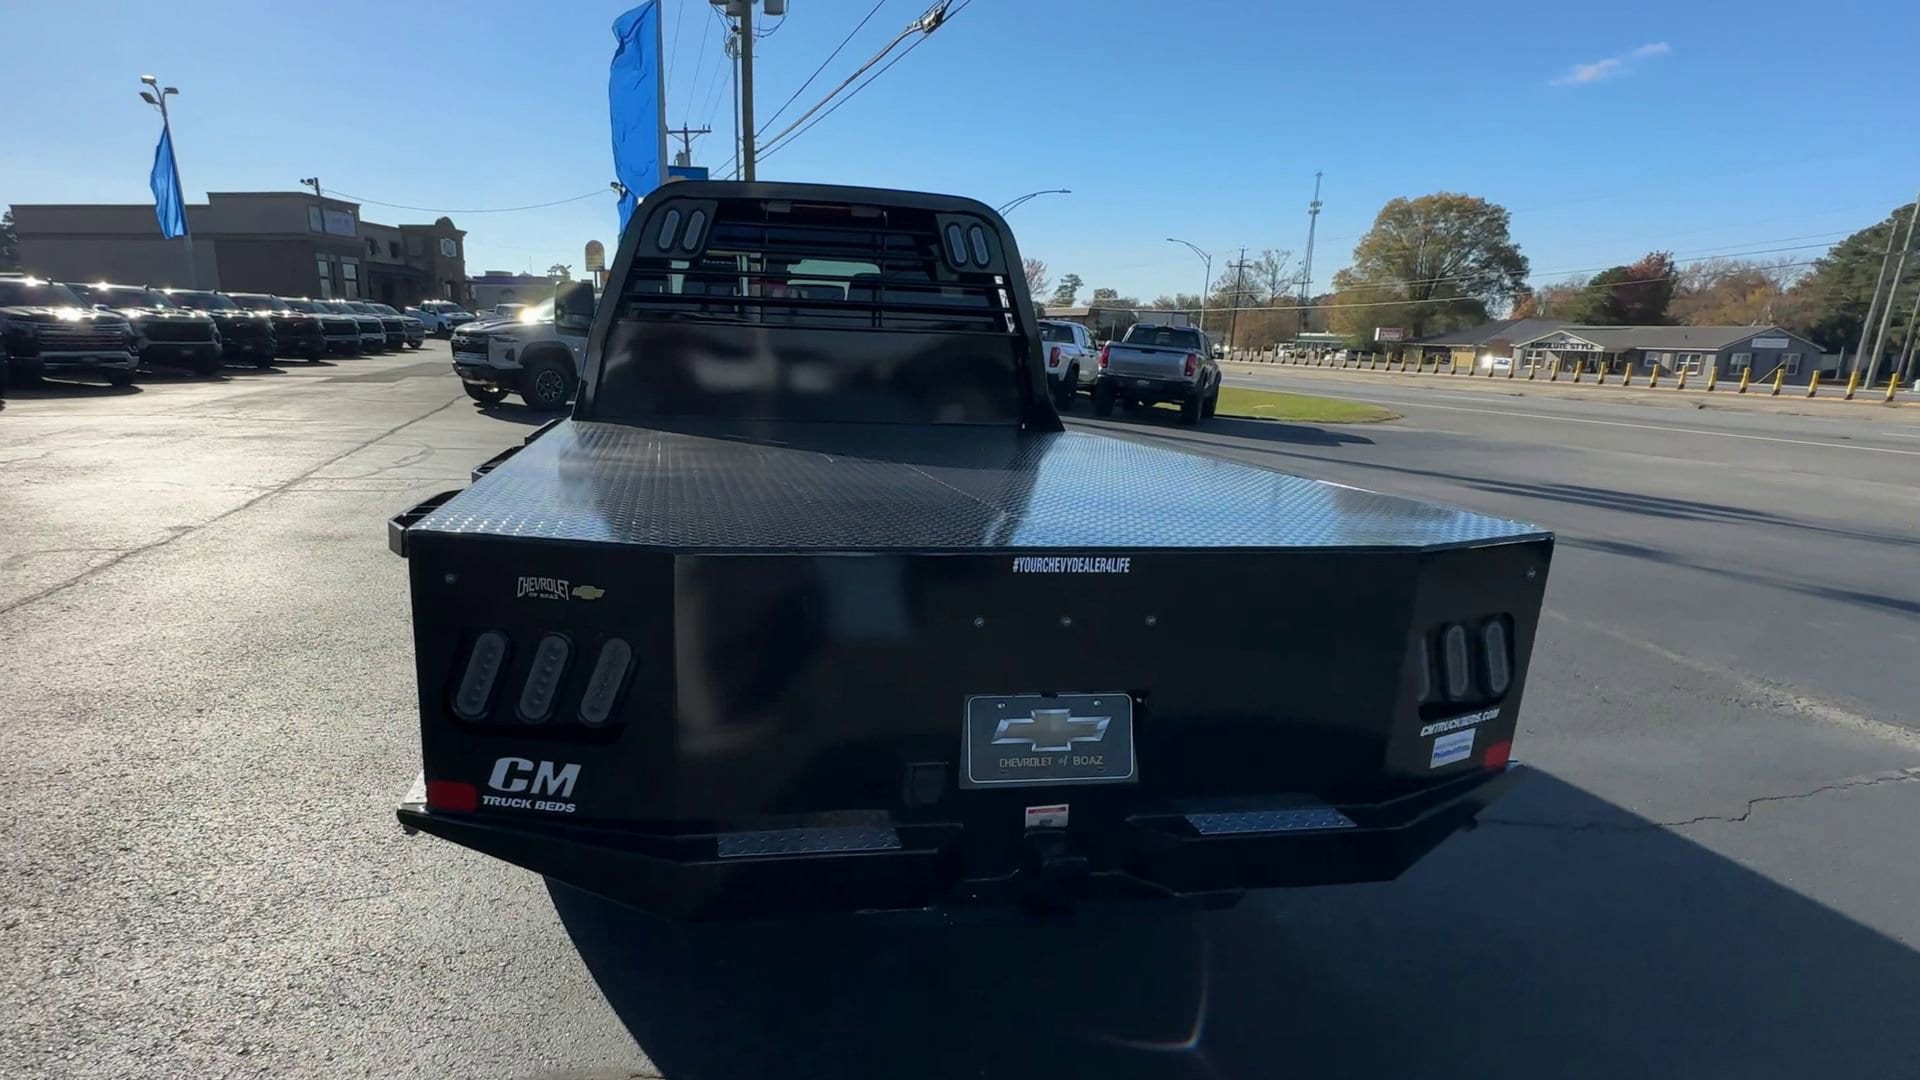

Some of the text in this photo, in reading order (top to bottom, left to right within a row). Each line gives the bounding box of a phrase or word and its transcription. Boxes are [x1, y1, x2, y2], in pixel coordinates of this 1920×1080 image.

[1012, 557, 1130, 573] #YOURCHEVYDEALER4LIFE
[517, 576, 569, 600] CHEVROLET
[999, 757, 1052, 768] CHEVROLET
[1073, 755, 1103, 766] BOAZ
[487, 757, 581, 798] CM
[482, 795, 576, 813] TRUCK BEDS
